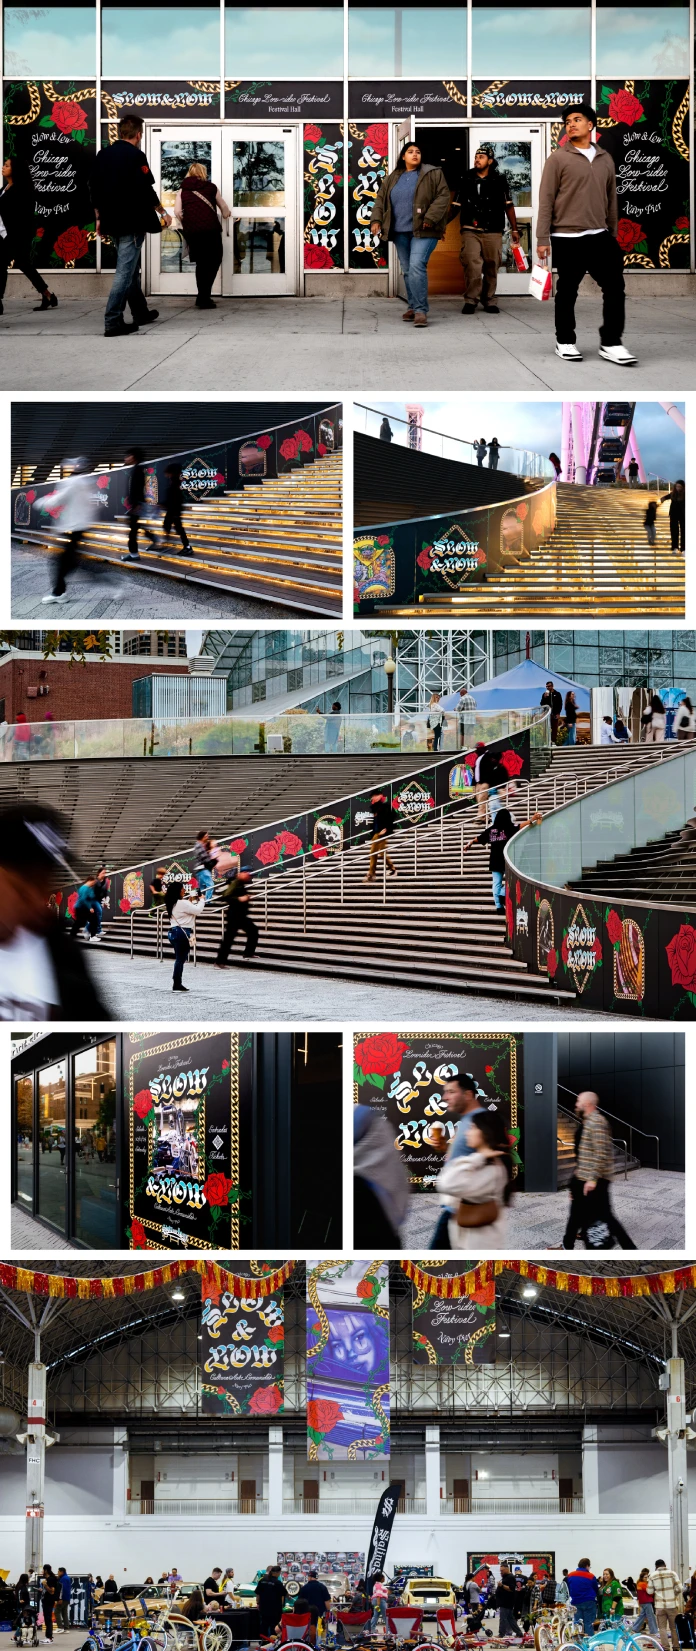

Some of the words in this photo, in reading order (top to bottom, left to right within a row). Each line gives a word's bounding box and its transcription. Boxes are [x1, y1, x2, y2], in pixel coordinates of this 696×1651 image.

[33, 149, 69, 169] Chicago
[358, 145, 382, 168] &
[624, 149, 661, 169] Chicago
[616, 178, 669, 195] Festival
[424, 1093, 449, 1116] &
[431, 1312, 477, 1327] Festival
[232, 1319, 256, 1341] &
[675, 1395, 681, 1403] 6
